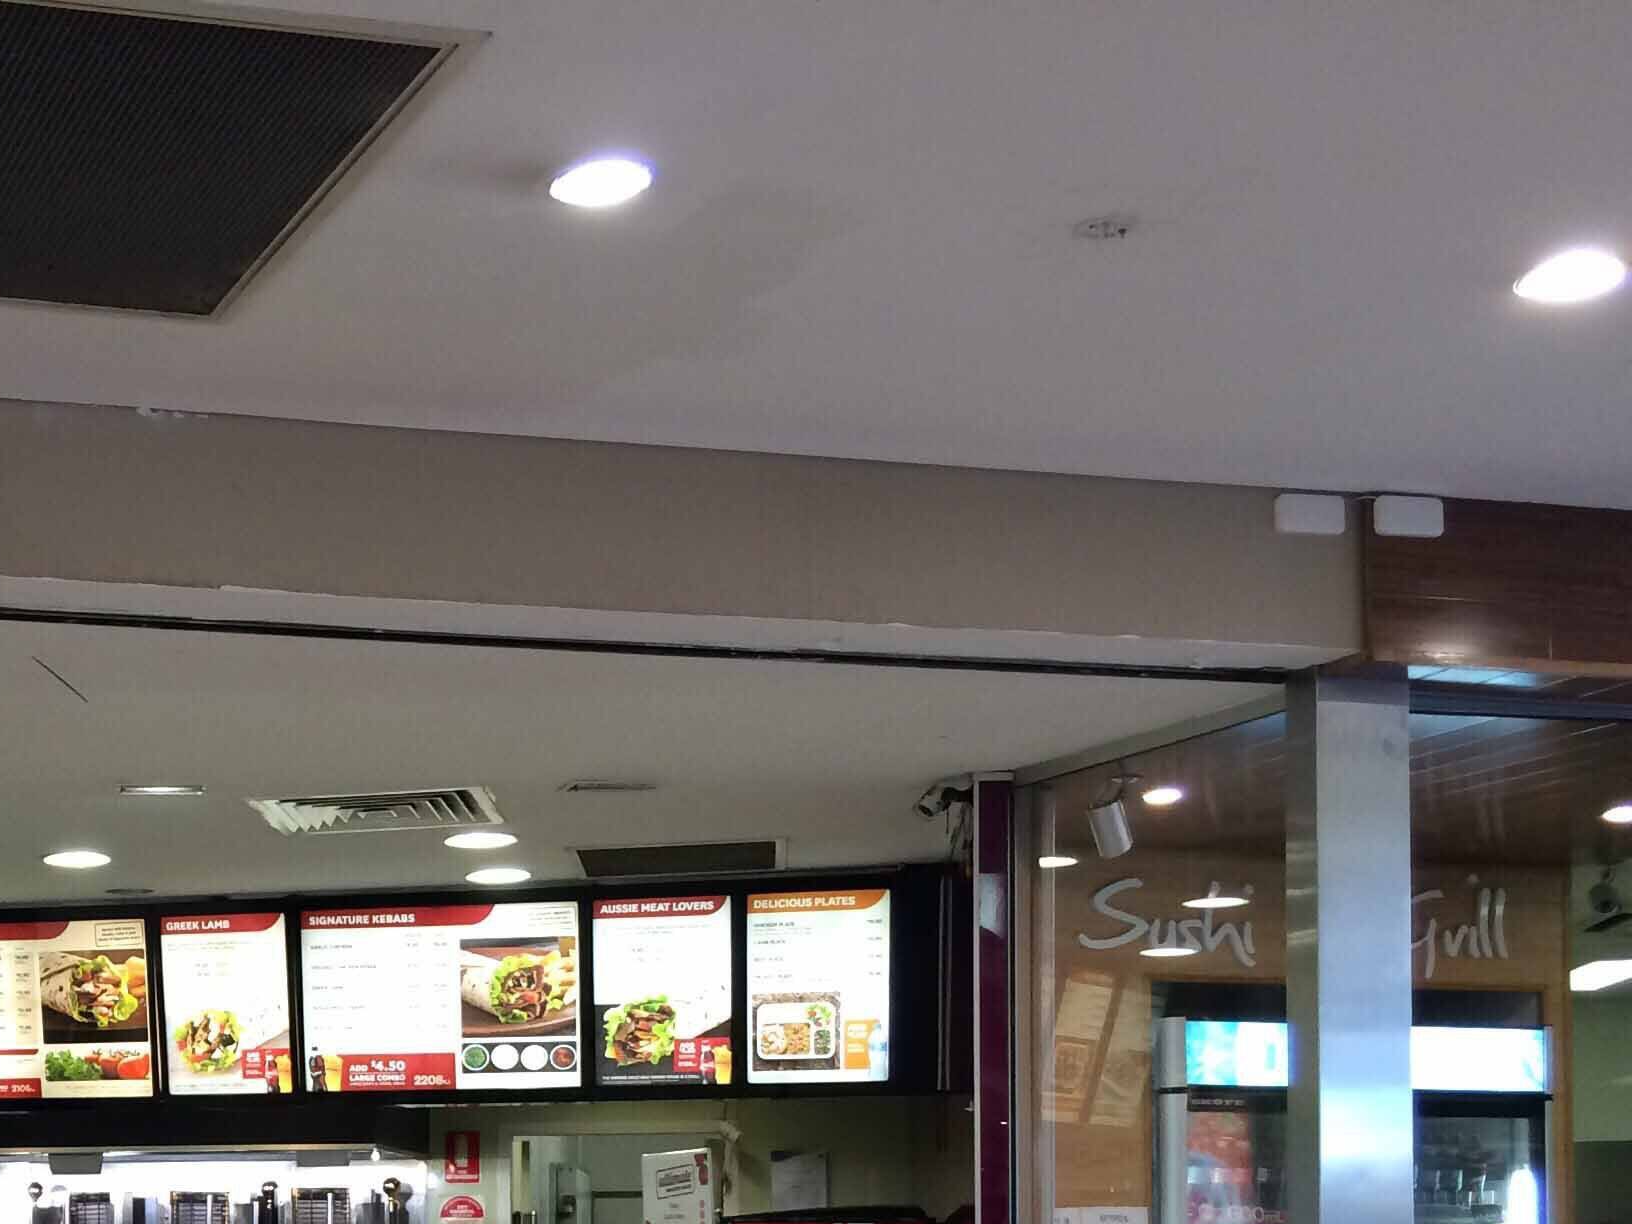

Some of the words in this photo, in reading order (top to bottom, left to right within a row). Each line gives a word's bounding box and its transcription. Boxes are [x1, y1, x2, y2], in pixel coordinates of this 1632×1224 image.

[600, 903, 639, 914] AUSSIE
[641, 902, 669, 913] MEAT
[673, 901, 714, 912] LOVERS
[753, 897, 812, 909] DELICIOUS
[815, 896, 855, 907] PLATES
[166, 920, 199, 931] GREEK
[202, 919, 230, 930] LAMB
[309, 915, 369, 926] SIGNATURE
[372, 914, 415, 925] KEBABS
[1079, 878, 1256, 967] Sushi
[349, 1064, 368, 1073] ADD
[349, 1073, 375, 1083] LARGE
[377, 1072, 405, 1082] COMBO
